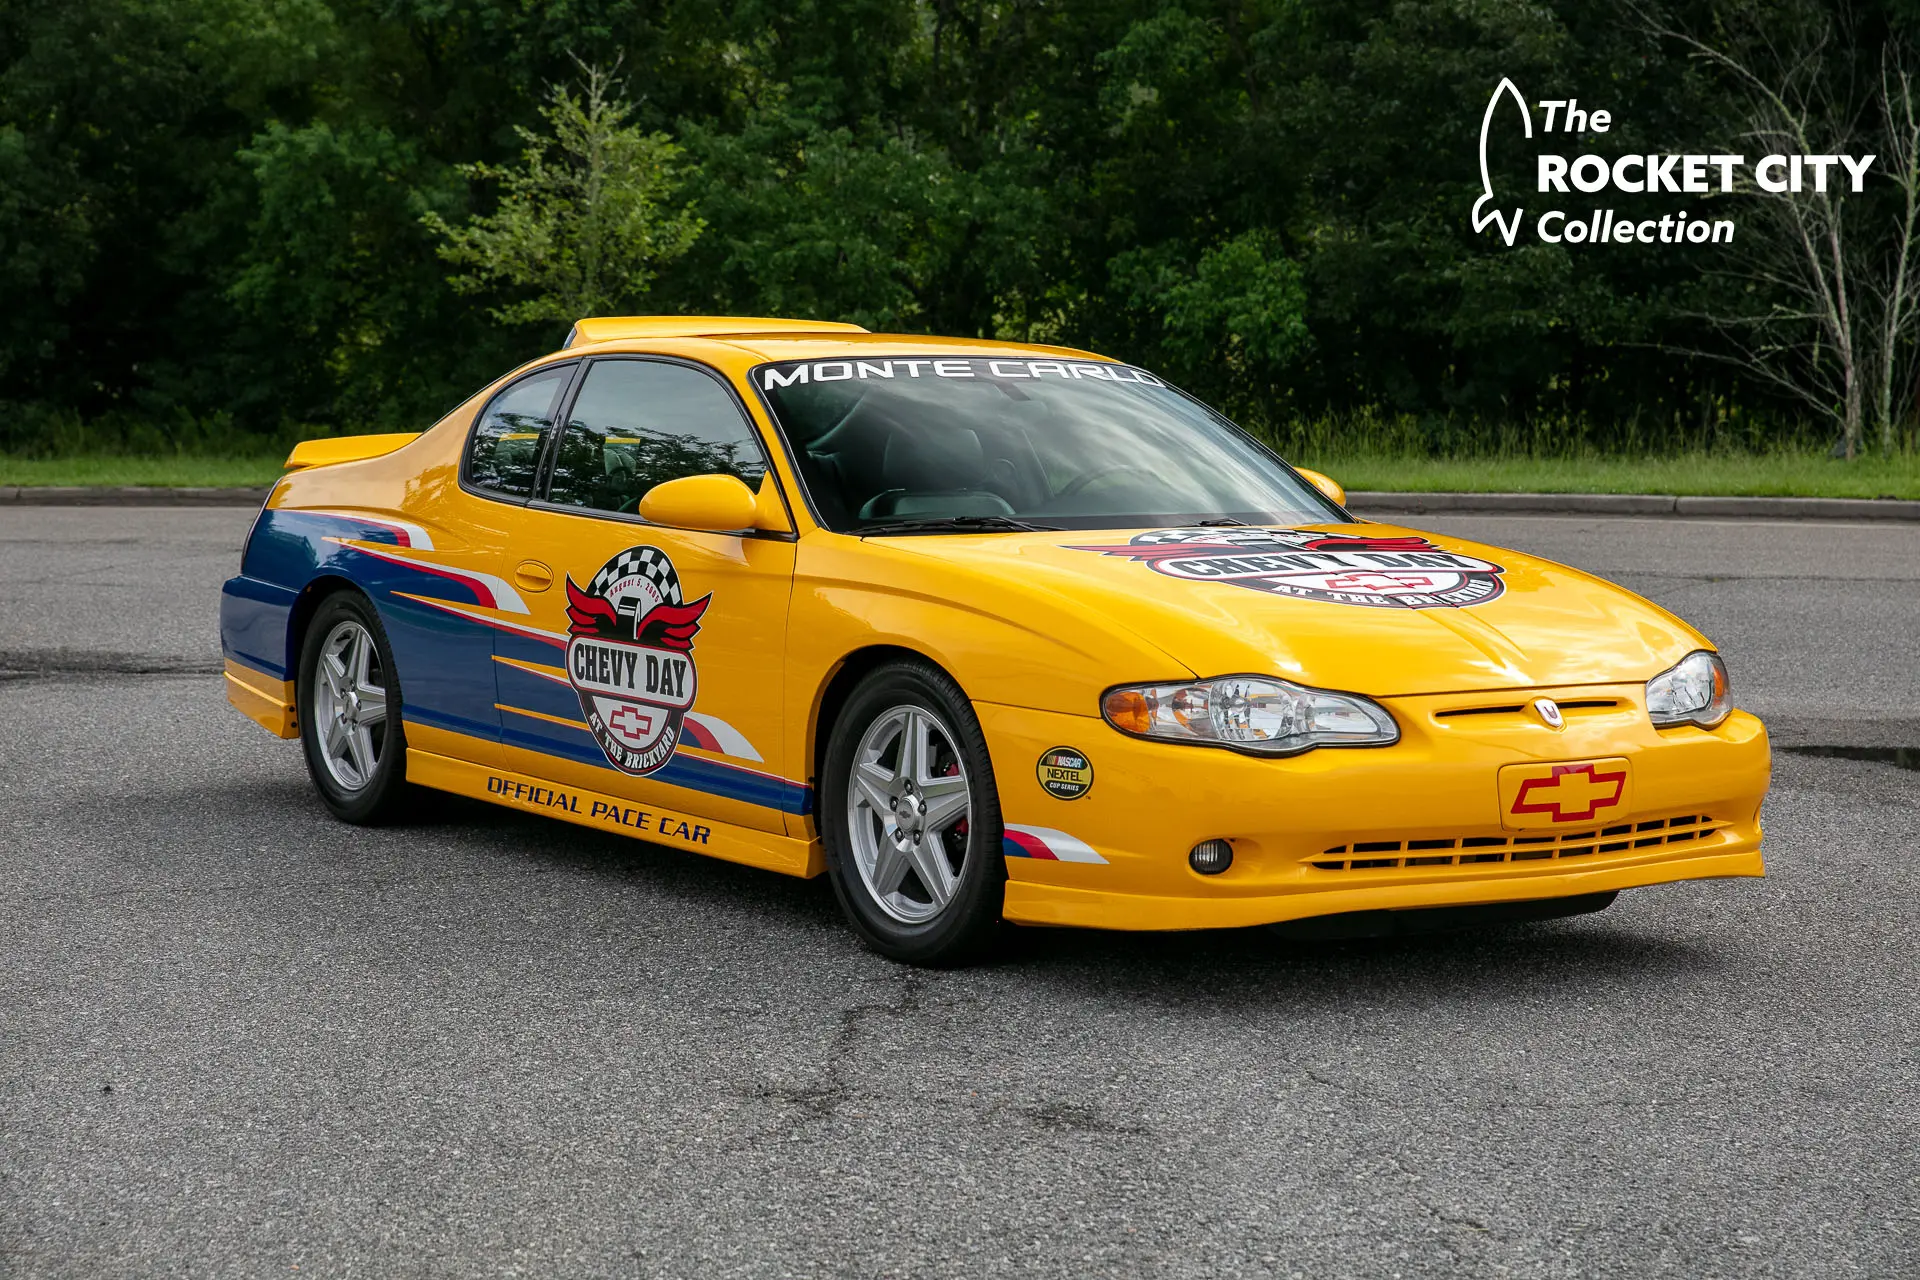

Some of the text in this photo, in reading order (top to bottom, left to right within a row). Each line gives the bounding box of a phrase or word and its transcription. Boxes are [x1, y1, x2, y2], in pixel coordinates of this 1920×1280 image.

[764, 360, 1166, 390] MONTE CARLO
[1167, 550, 1473, 577] CHEVY DAY
[610, 578, 634, 598] August
[1271, 585, 1314, 596] AT
[1327, 591, 1391, 605] THE
[573, 642, 687, 698] CHEVY DAY
[590, 712, 676, 769] AT THE BRICKYARD
[1057, 756, 1082, 769] NASCAR
[1047, 768, 1083, 782] NEXTEL
[1061, 783, 1080, 792] SERIES
[487, 776, 711, 845] OFFICIAL PACE CAR
